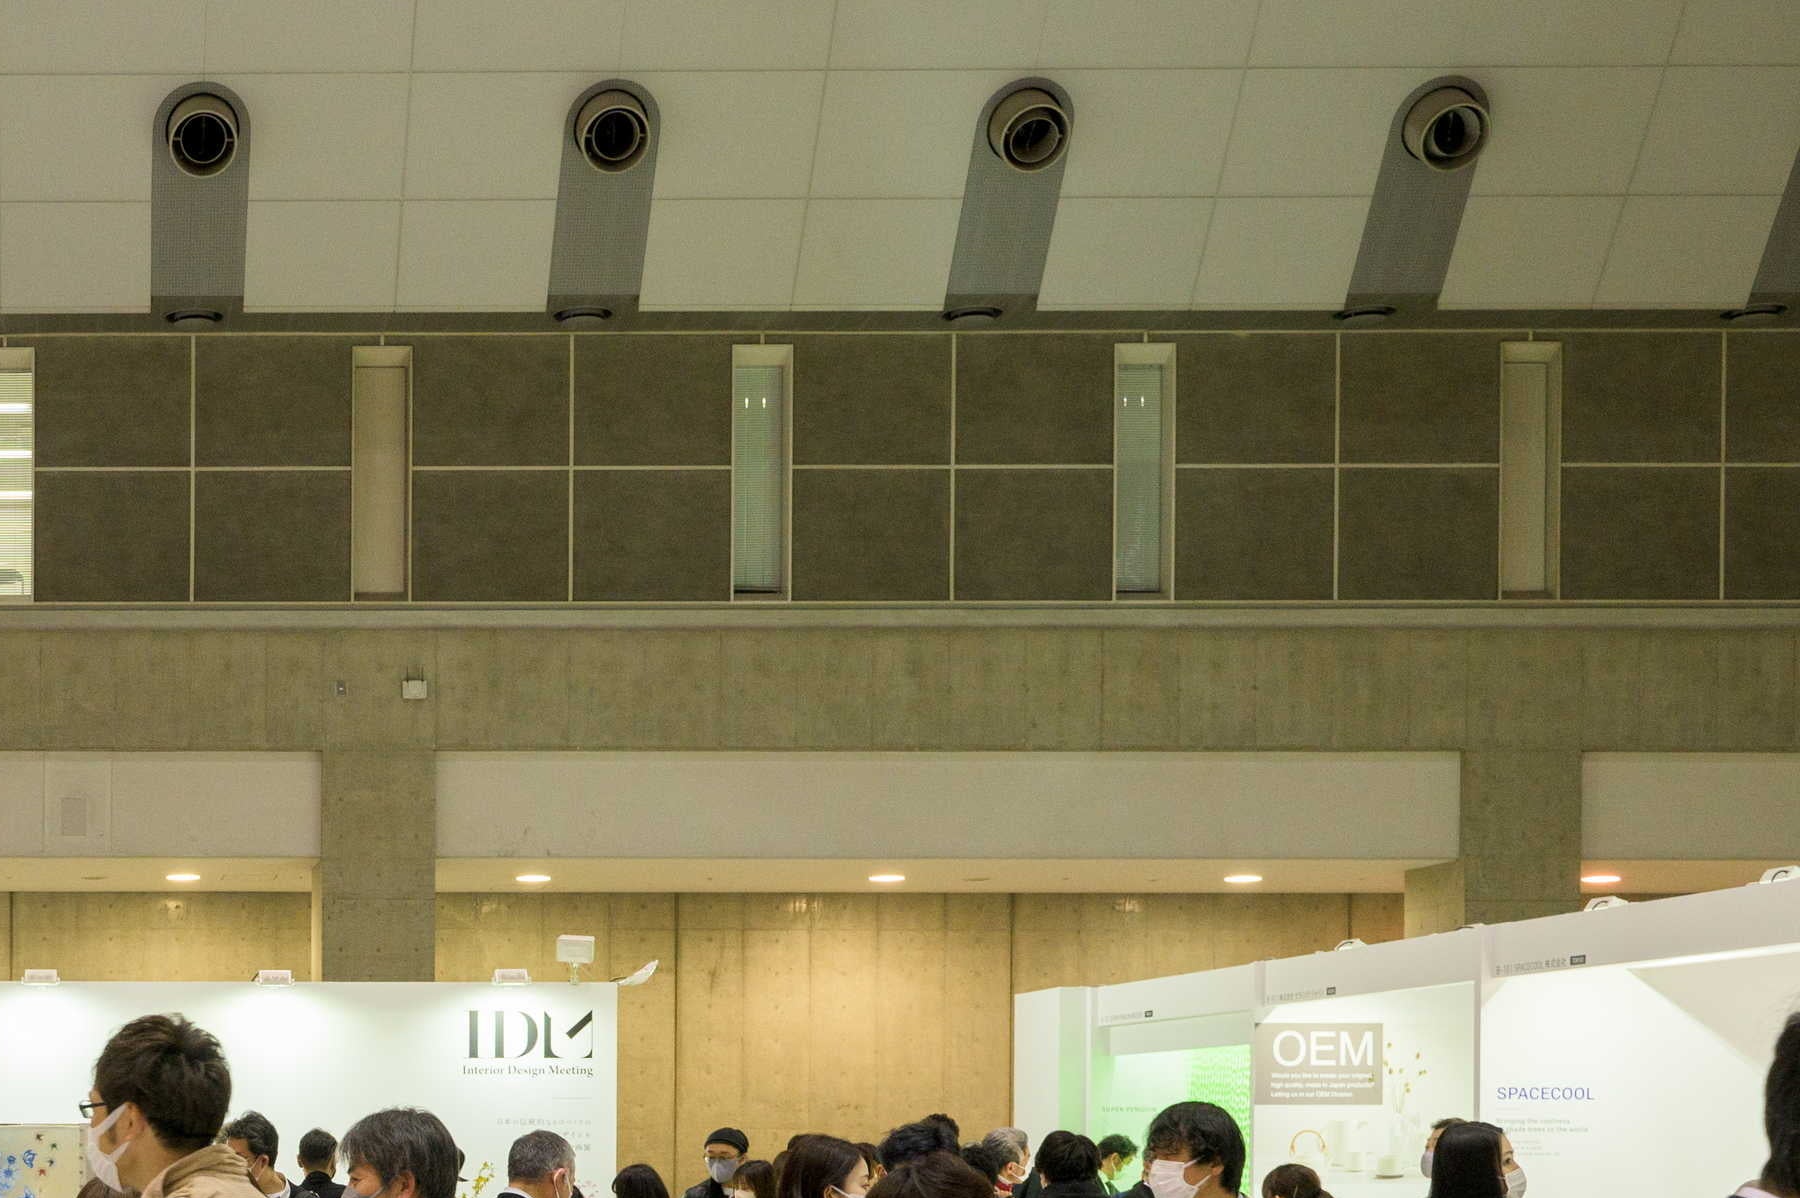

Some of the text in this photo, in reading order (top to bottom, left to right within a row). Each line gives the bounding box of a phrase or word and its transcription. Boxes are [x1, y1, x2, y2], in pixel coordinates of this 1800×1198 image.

[464, 1010, 593, 1059] IDM
[1272, 1030, 1374, 1067] OEM
[463, 1065, 594, 1078] Interior Design Meeting
[1496, 1087, 1595, 1100] SPACECOOL
